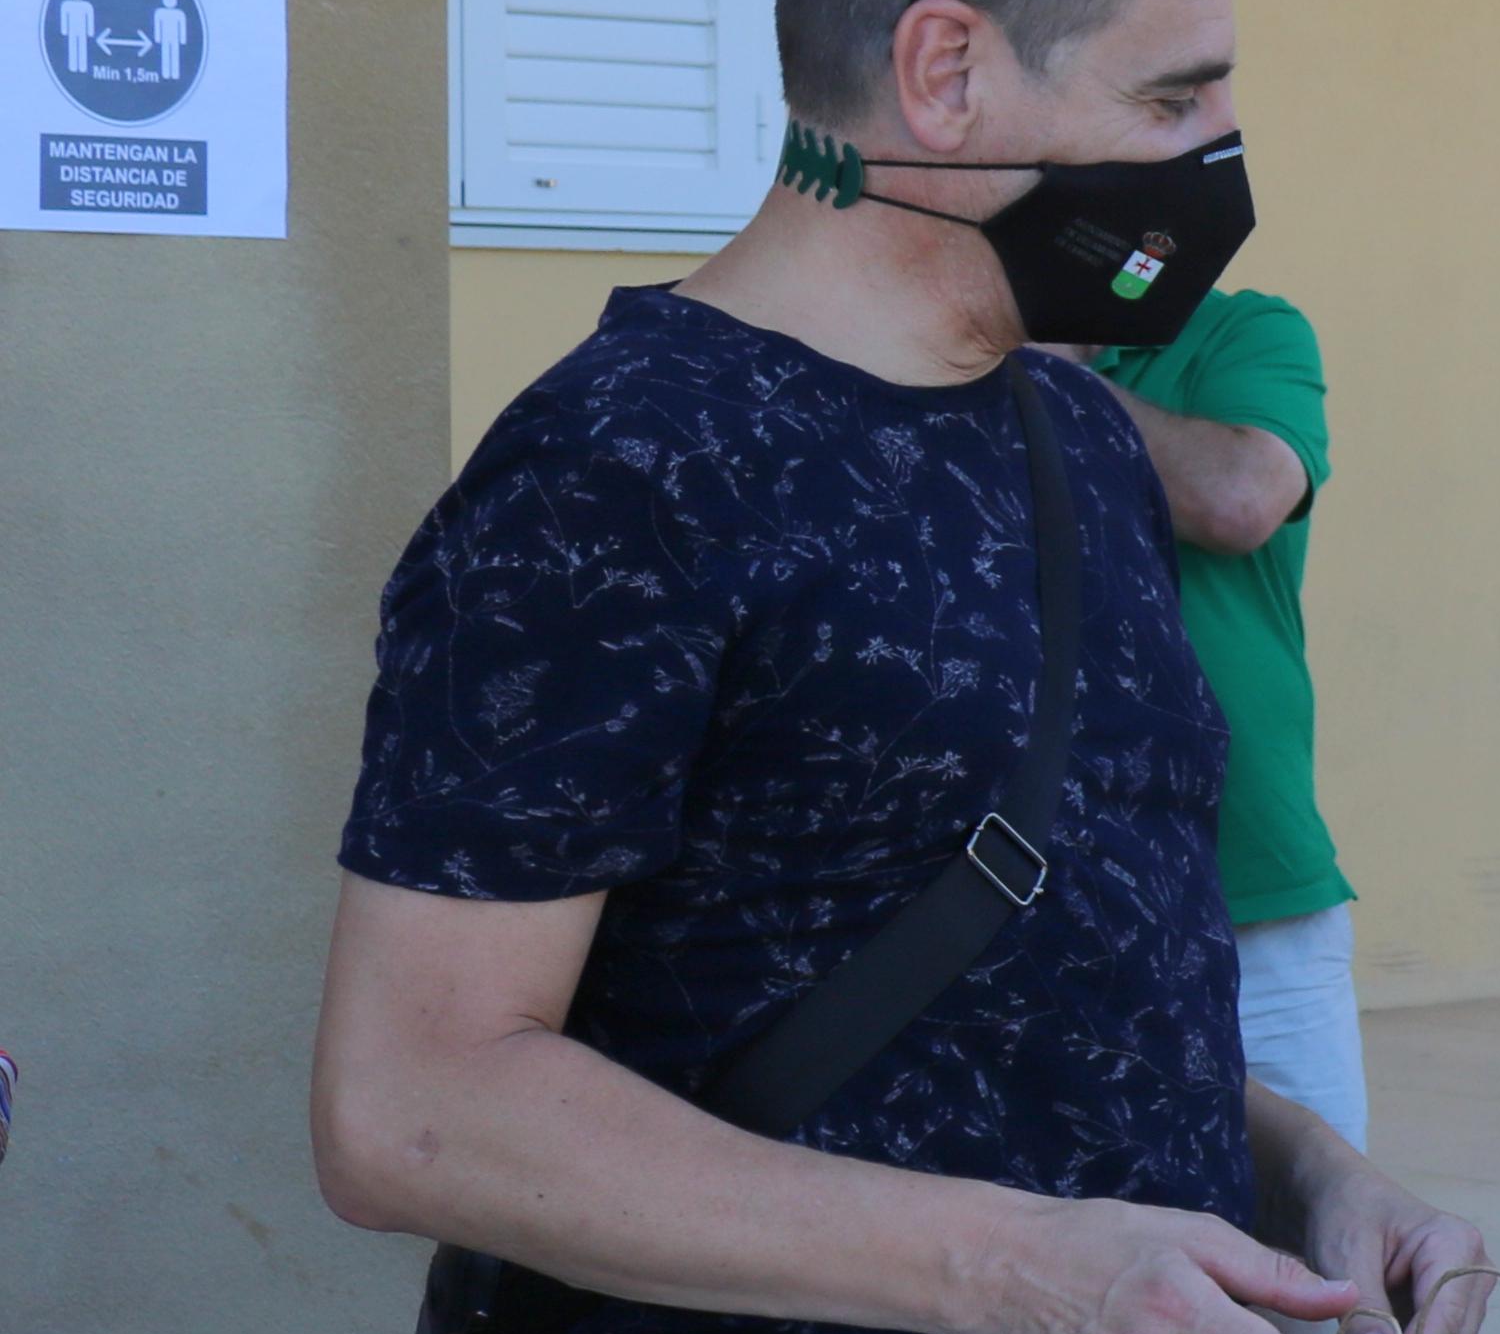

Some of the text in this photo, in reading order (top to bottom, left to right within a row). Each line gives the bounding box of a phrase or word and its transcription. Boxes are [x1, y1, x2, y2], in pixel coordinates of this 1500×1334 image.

[124, 67, 160, 83] 1,5m
[49, 141, 197, 164] MANTENGAN LA
[60, 165, 188, 187] DISTANCIA DE
[70, 189, 179, 210] SEGURIDAD
